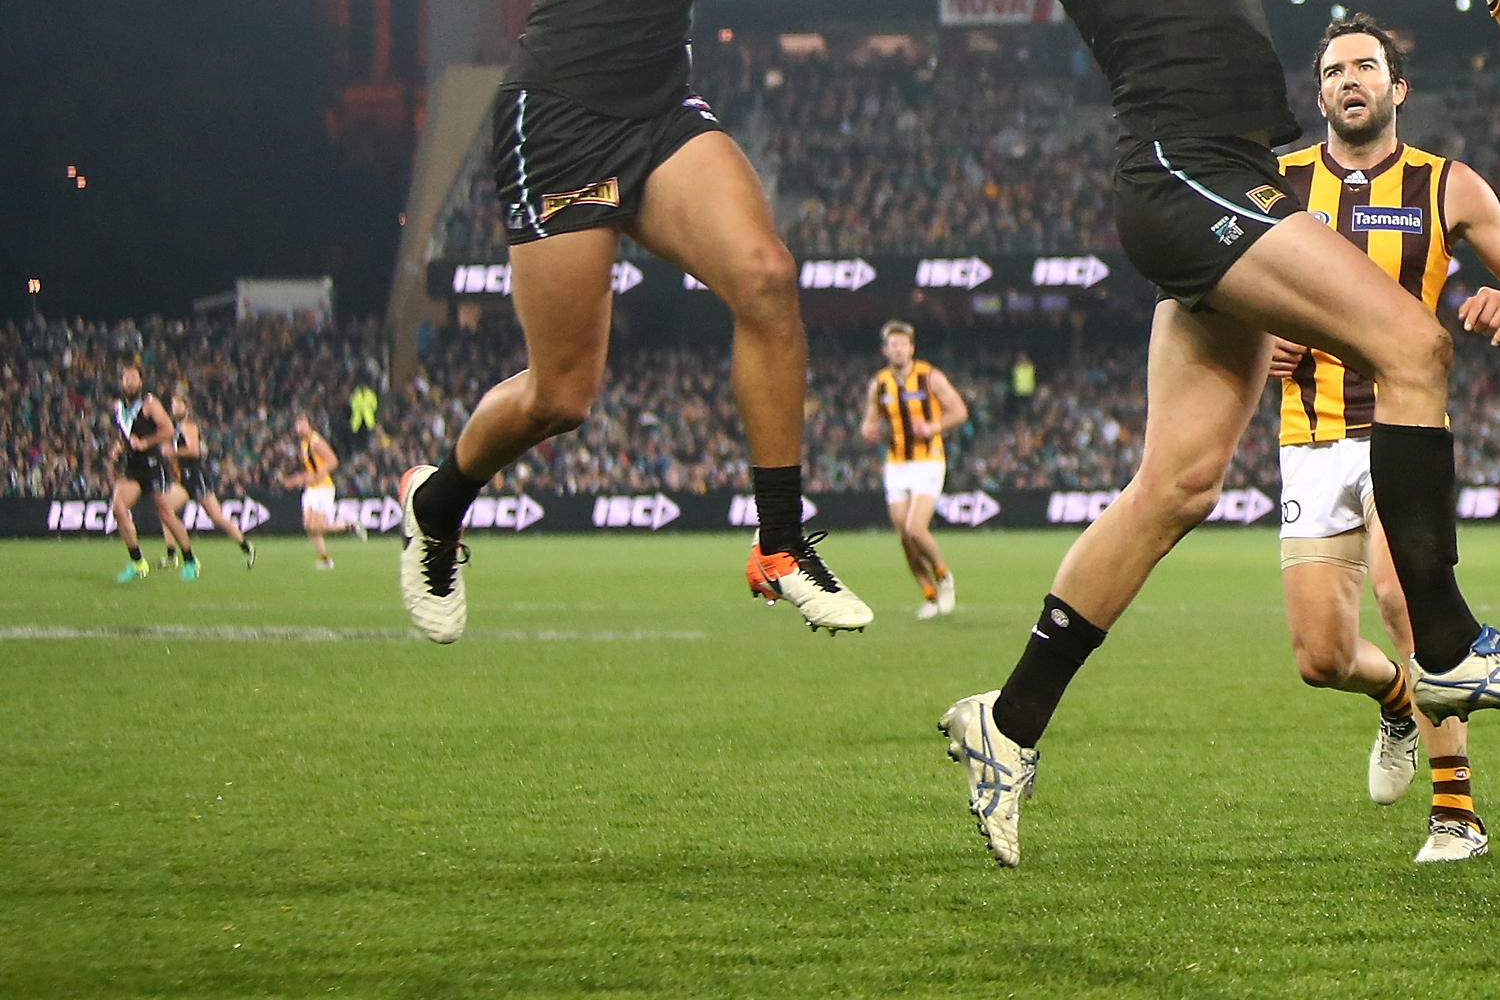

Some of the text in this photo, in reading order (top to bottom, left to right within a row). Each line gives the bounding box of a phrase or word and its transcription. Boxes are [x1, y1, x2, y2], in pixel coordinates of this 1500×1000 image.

[1354, 212, 1421, 228] Tasmania
[48, 501, 108, 530] ISC
[592, 496, 655, 527] ISC
[1456, 487, 1499, 518] IS
